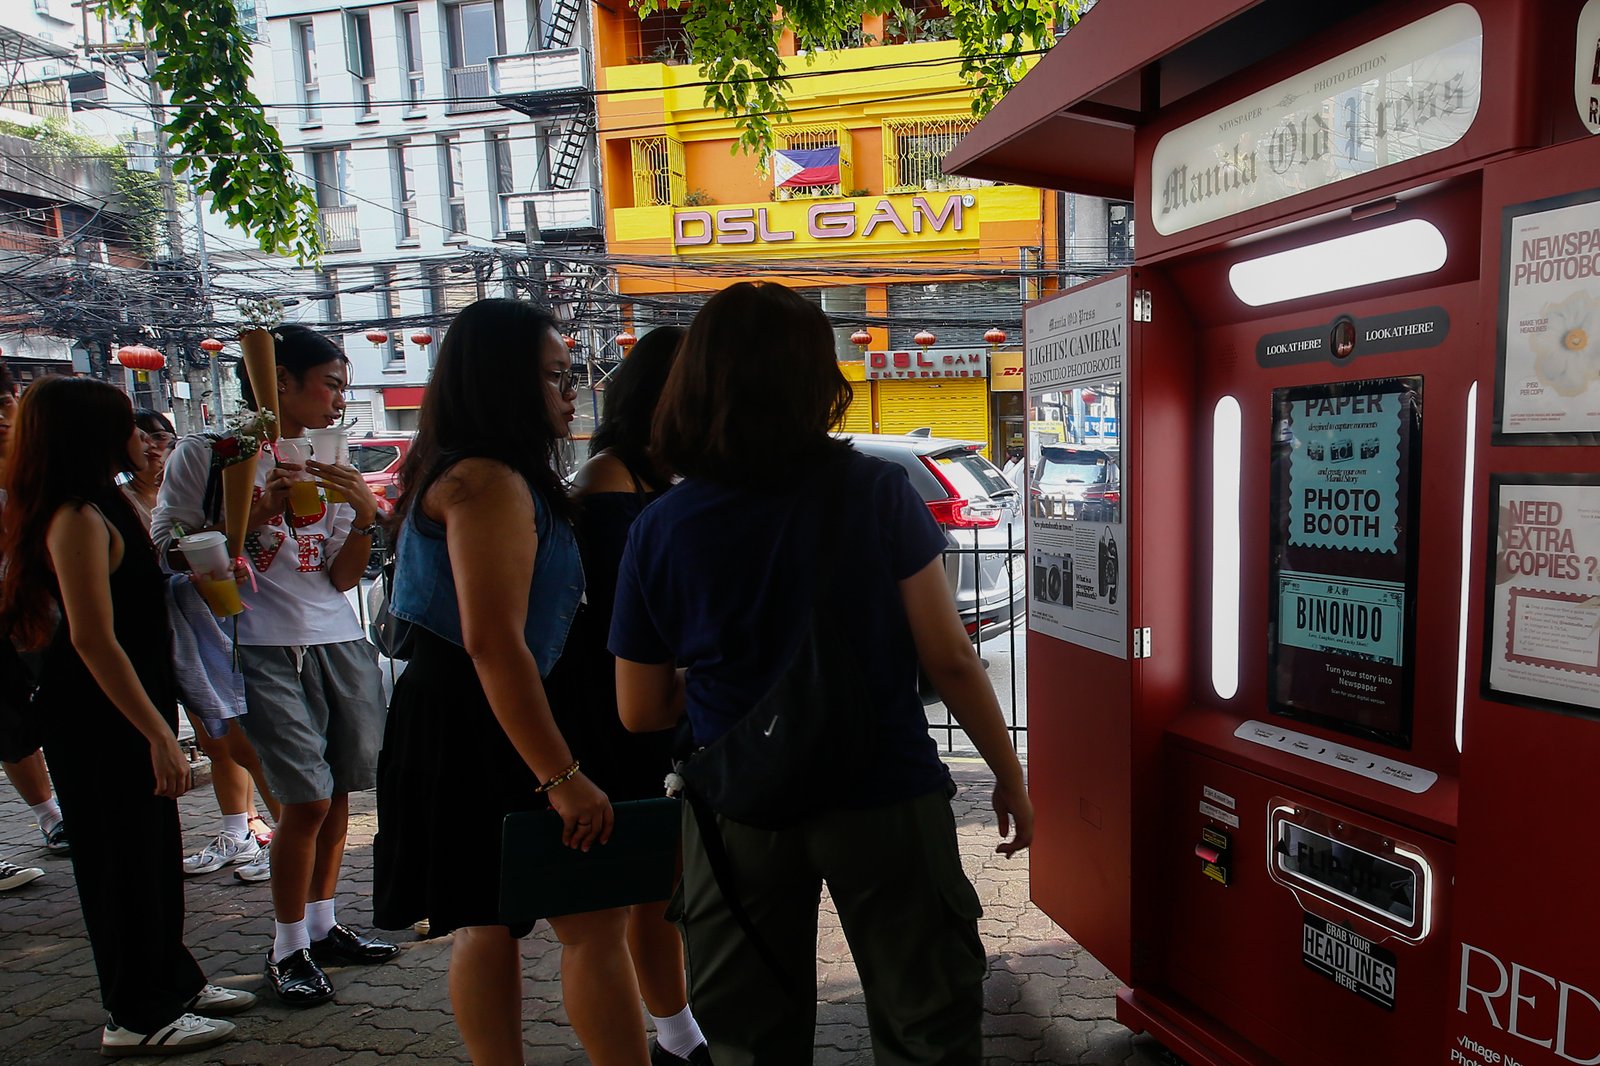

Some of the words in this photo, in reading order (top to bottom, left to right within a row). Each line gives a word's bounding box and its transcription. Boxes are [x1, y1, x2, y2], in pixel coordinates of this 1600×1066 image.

[1218, 107, 1263, 132] NEWSPAPER
[1313, 72, 1345, 93] PHOTO
[1347, 53, 1388, 79] EDITION
[1162, 143, 1258, 214] Manila
[1268, 112, 1329, 175] Old
[1344, 70, 1465, 162] Press
[674, 208, 795, 246] DSL
[807, 195, 963, 238] GAM
[1049, 316, 1066, 332] Manila
[1079, 309, 1096, 325] Press
[1366, 328, 1393, 341] LOOK
[1405, 322, 1435, 336] HERE!
[1030, 338, 1068, 367] LIGHTS!
[1069, 324, 1121, 357] CAMERA!
[1266, 344, 1288, 356] LOOK
[1298, 339, 1322, 351] HERE!
[870, 352, 934, 368] DSL
[942, 353, 980, 365] GAM
[1030, 371, 1043, 385] RED
[1043, 366, 1066, 382] STUDIO
[1067, 355, 1121, 378] PHOTOBOOTH
[1305, 393, 1383, 417] PAPER
[1304, 488, 1381, 512] PHOTO
[1509, 500, 1562, 526] NEED
[1303, 513, 1380, 538] BOOTH
[1507, 526, 1575, 553] EXTRA
[1296, 597, 1382, 643] BINONDO
[1326, 664, 1341, 675] Turn
[1342, 667, 1357, 678] your
[1359, 671, 1377, 684] story
[1378, 674, 1393, 685] into
[1339, 677, 1377, 692] Newspaper
[1326, 923, 1347, 942] GRAB
[1349, 933, 1370, 954] YOUR
[1304, 925, 1395, 996] HEADLINES
[1335, 971, 1357, 993] HERE
[1456, 1035, 1501, 1064] Vintage
